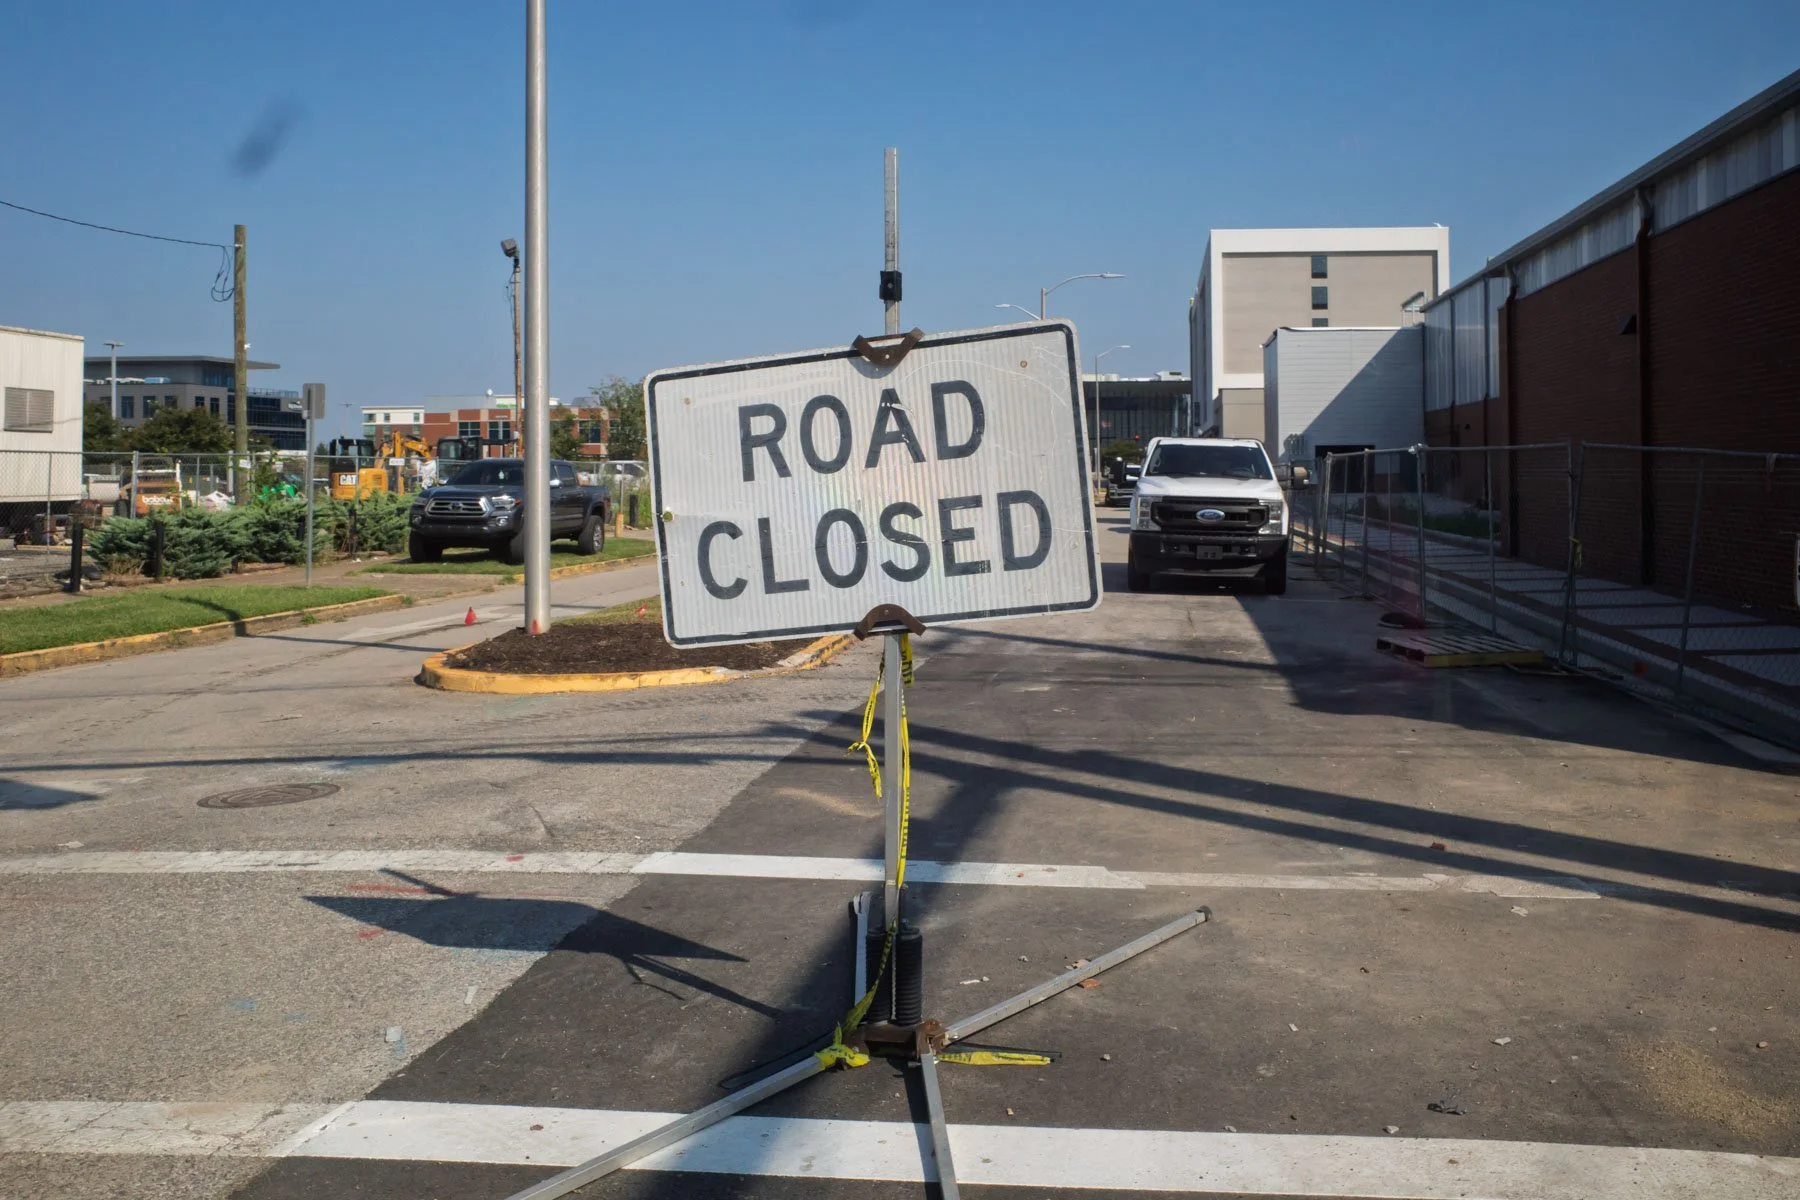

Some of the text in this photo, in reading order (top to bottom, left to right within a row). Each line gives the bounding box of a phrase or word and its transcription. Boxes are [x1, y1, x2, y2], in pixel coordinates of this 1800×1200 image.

[340, 474, 357, 485] CAT
[738, 380, 985, 482] ROAD
[697, 489, 1052, 600] CLOSED
